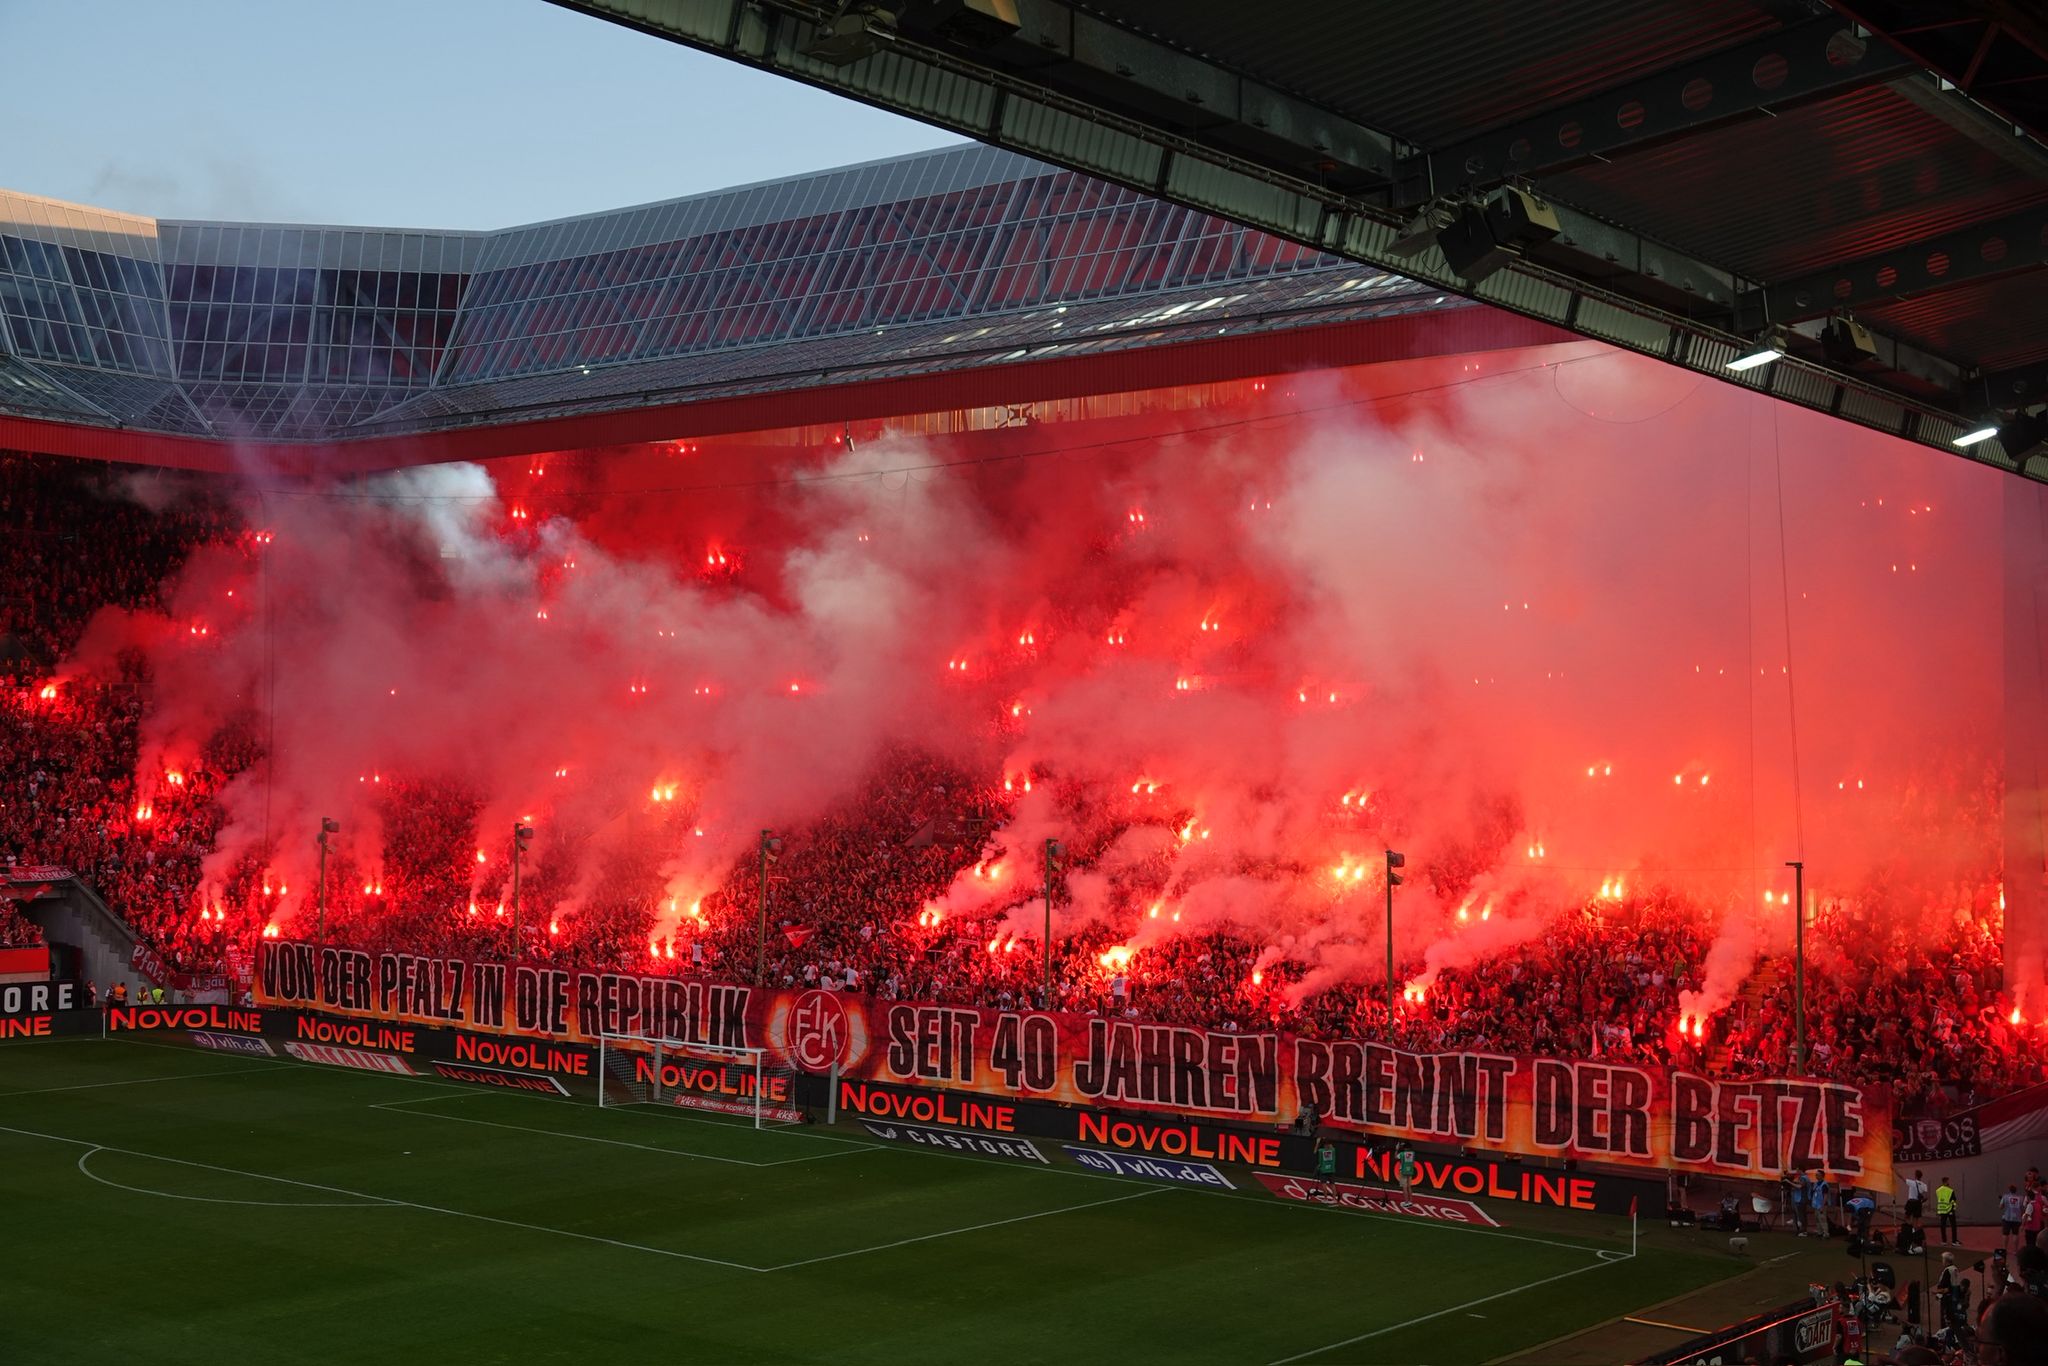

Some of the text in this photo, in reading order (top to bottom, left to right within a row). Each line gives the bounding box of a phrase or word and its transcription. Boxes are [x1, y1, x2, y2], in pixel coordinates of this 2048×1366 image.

[132, 944, 166, 984] Pfalz
[191, 974, 226, 991] Algäu
[3, 983, 74, 1014] ORE
[262, 940, 752, 1057] VON DER PFALZ IN DIE REPUBLIK
[217, 1036, 266, 1054] vlh.de
[886, 1004, 1864, 1177] SEIT 40 JAHREN BRENNT DER BETZE
[906, 1130, 1038, 1162] CASTORE
[1126, 1158, 1222, 1186] vlh.de
